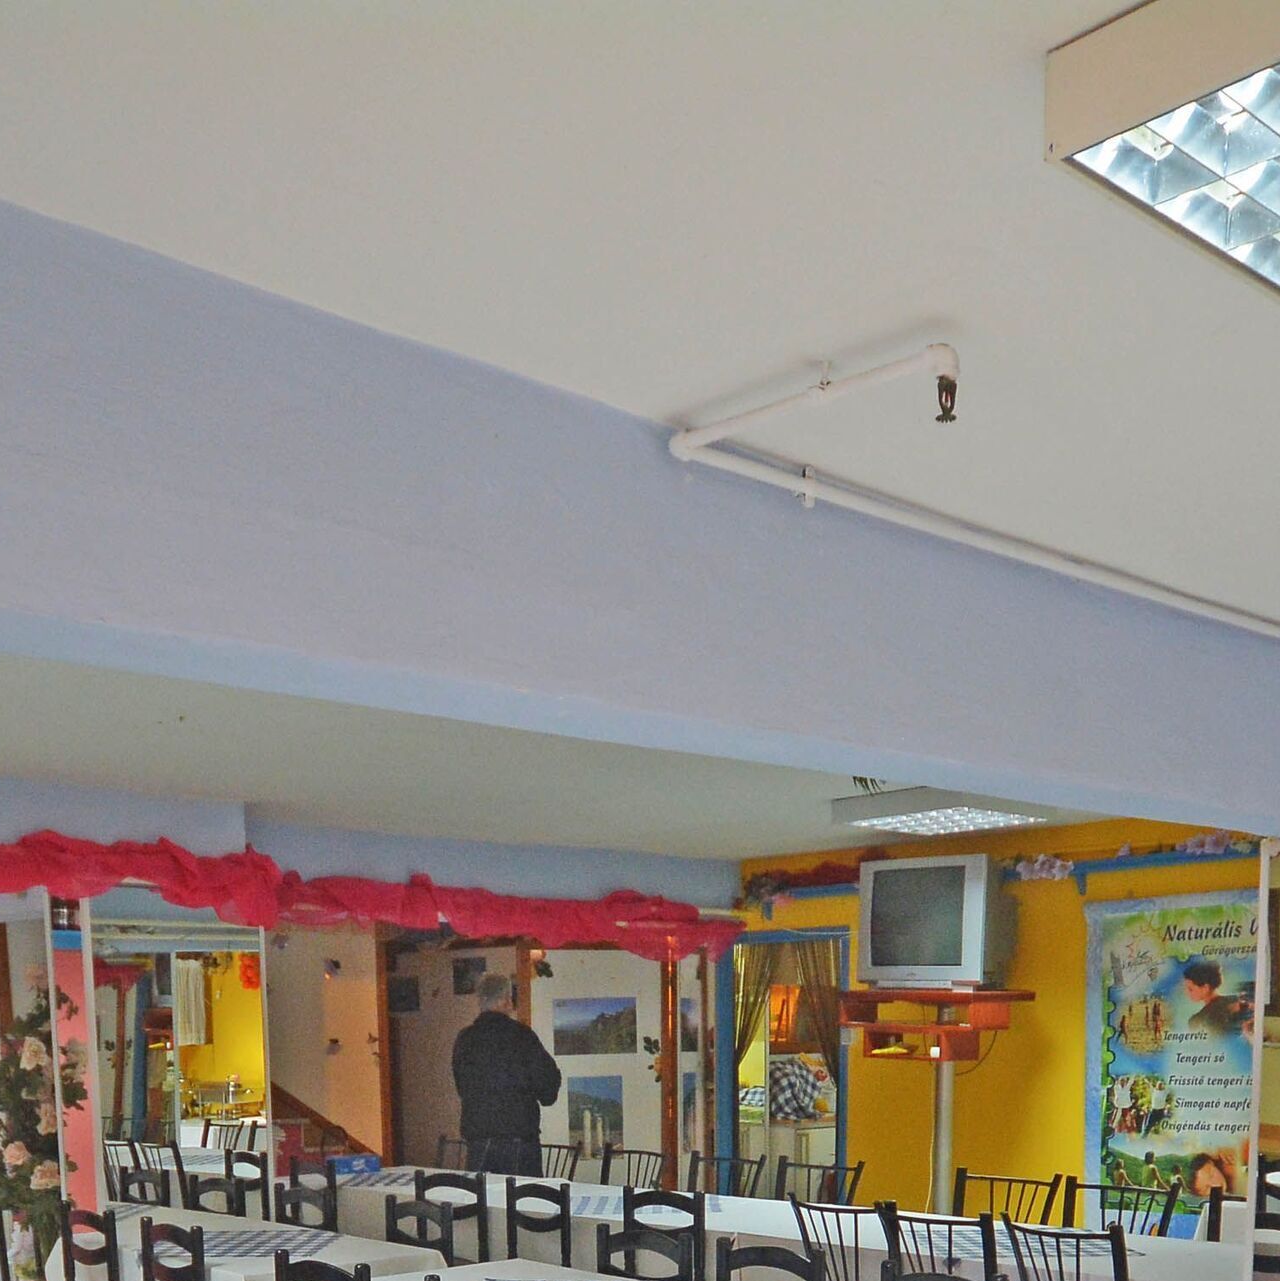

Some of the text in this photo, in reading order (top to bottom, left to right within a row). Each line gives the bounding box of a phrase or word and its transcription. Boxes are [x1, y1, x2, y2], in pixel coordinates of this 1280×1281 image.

[1176, 1052, 1225, 1066] Tengeri só
[1207, 1075, 1244, 1088] tengeri
[1175, 1098, 1221, 1110] Simogató
[1214, 1122, 1251, 1134] tengeri
